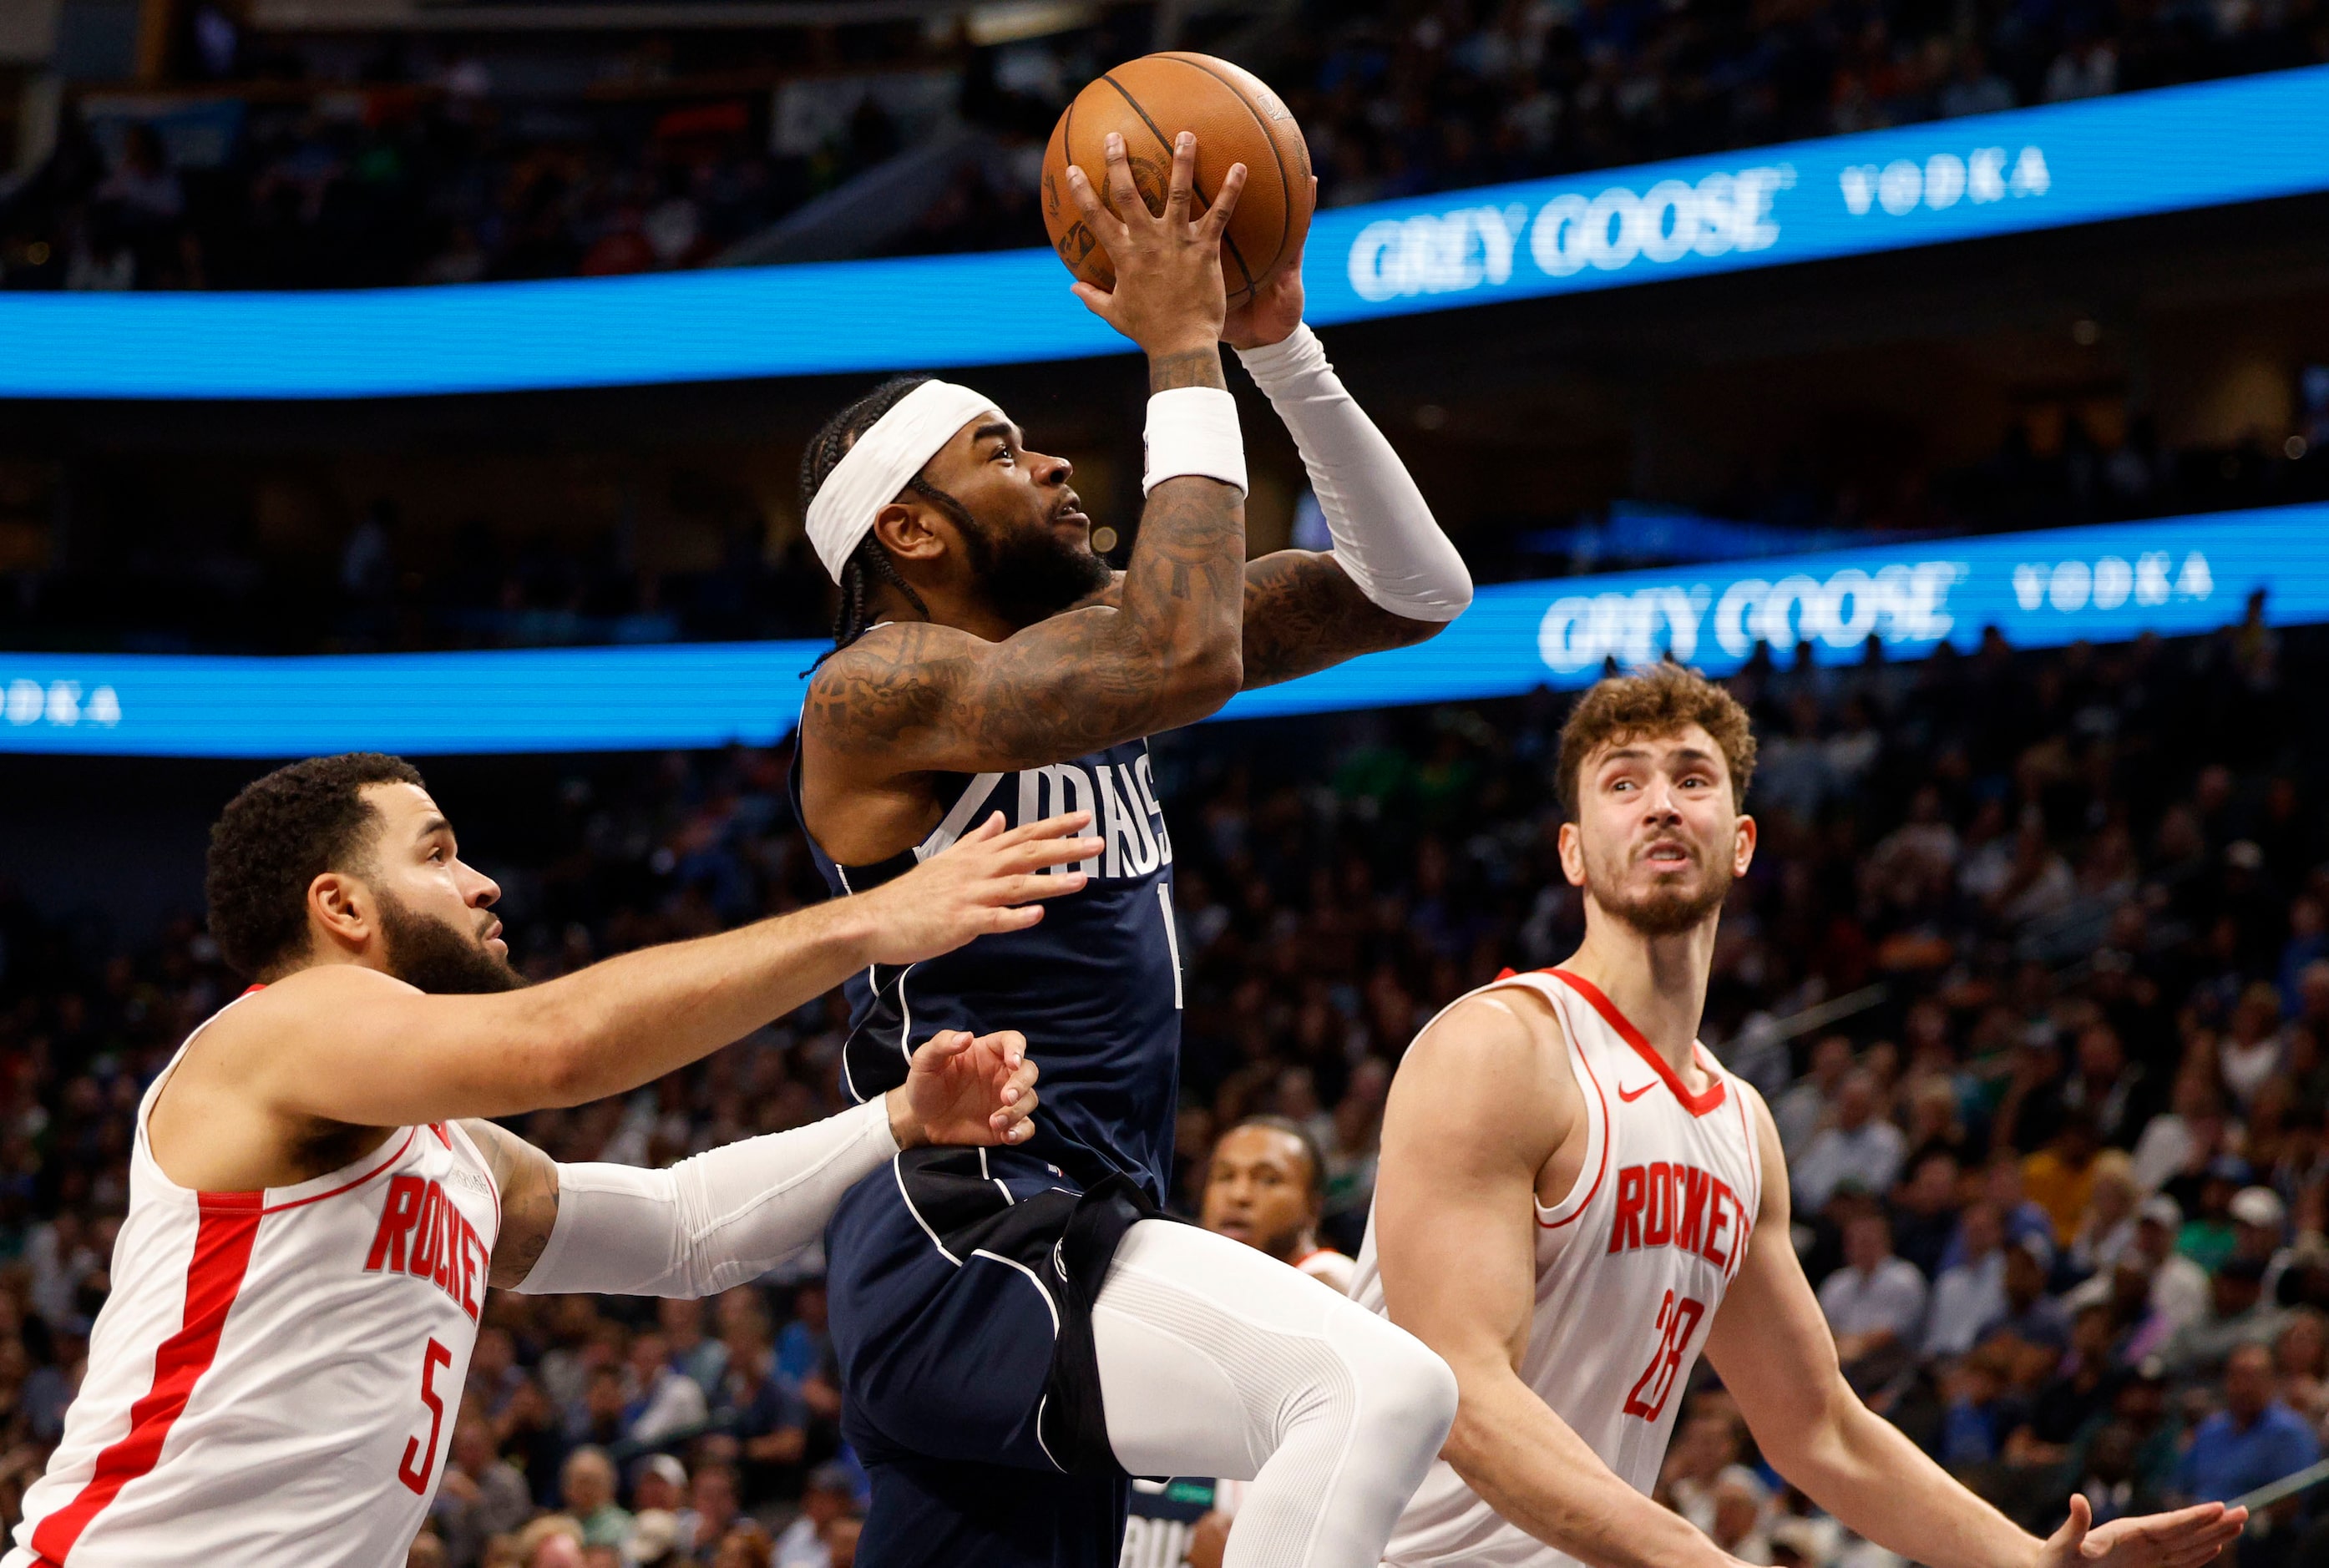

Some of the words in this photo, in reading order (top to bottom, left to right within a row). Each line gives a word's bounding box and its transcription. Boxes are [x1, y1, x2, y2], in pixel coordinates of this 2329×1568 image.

[1346, 203, 1527, 302] GREY
[1532, 163, 1796, 276] GOOSE
[1840, 145, 2051, 216] VODKA
[1714, 562, 1969, 658] GOOSE
[2013, 550, 2214, 612] VODKA
[0, 678, 122, 729] DKA
[398, 1337, 452, 1496] 5
[1623, 1289, 1704, 1423] 28
